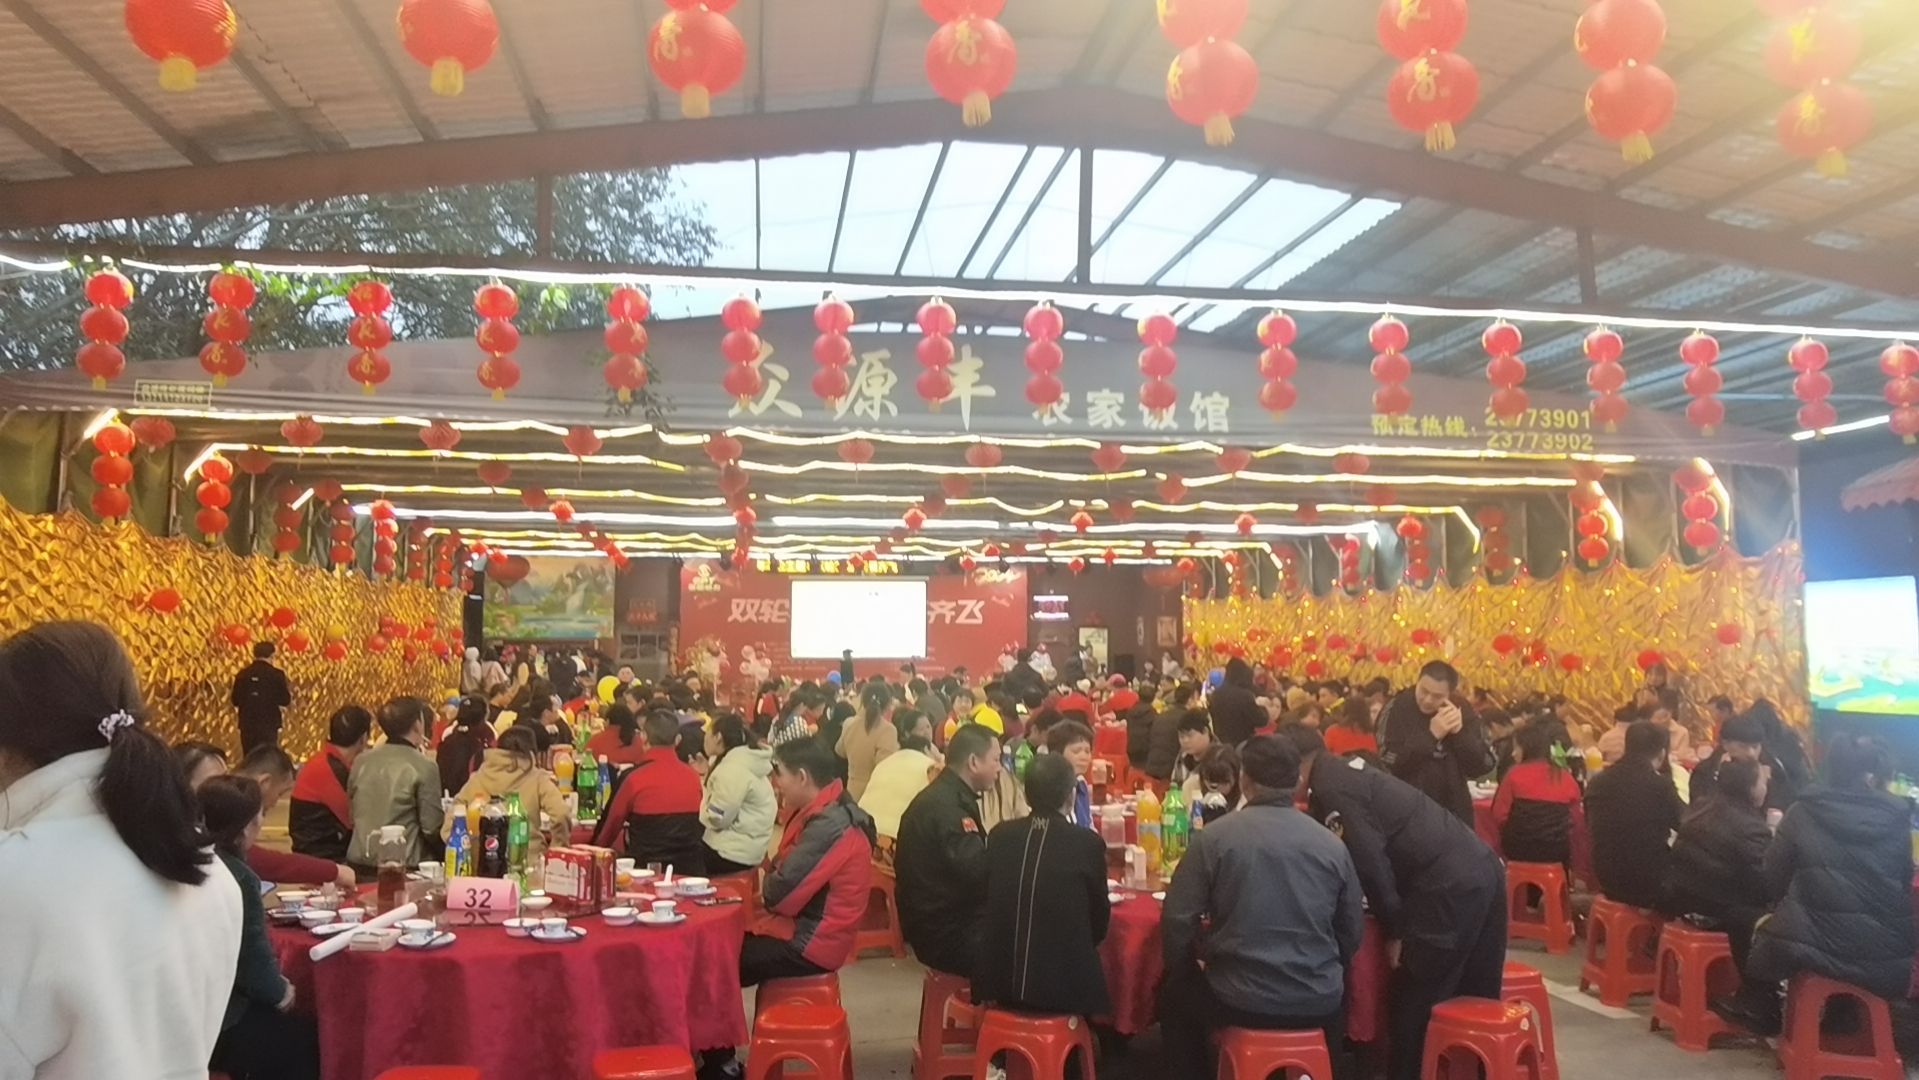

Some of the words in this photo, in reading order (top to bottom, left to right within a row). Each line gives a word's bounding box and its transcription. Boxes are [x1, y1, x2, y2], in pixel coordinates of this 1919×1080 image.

[1486, 430, 1594, 451] 23773902
[727, 598, 791, 624] 双轮
[927, 599, 986, 625] 齐飞
[463, 888, 493, 909] 32
